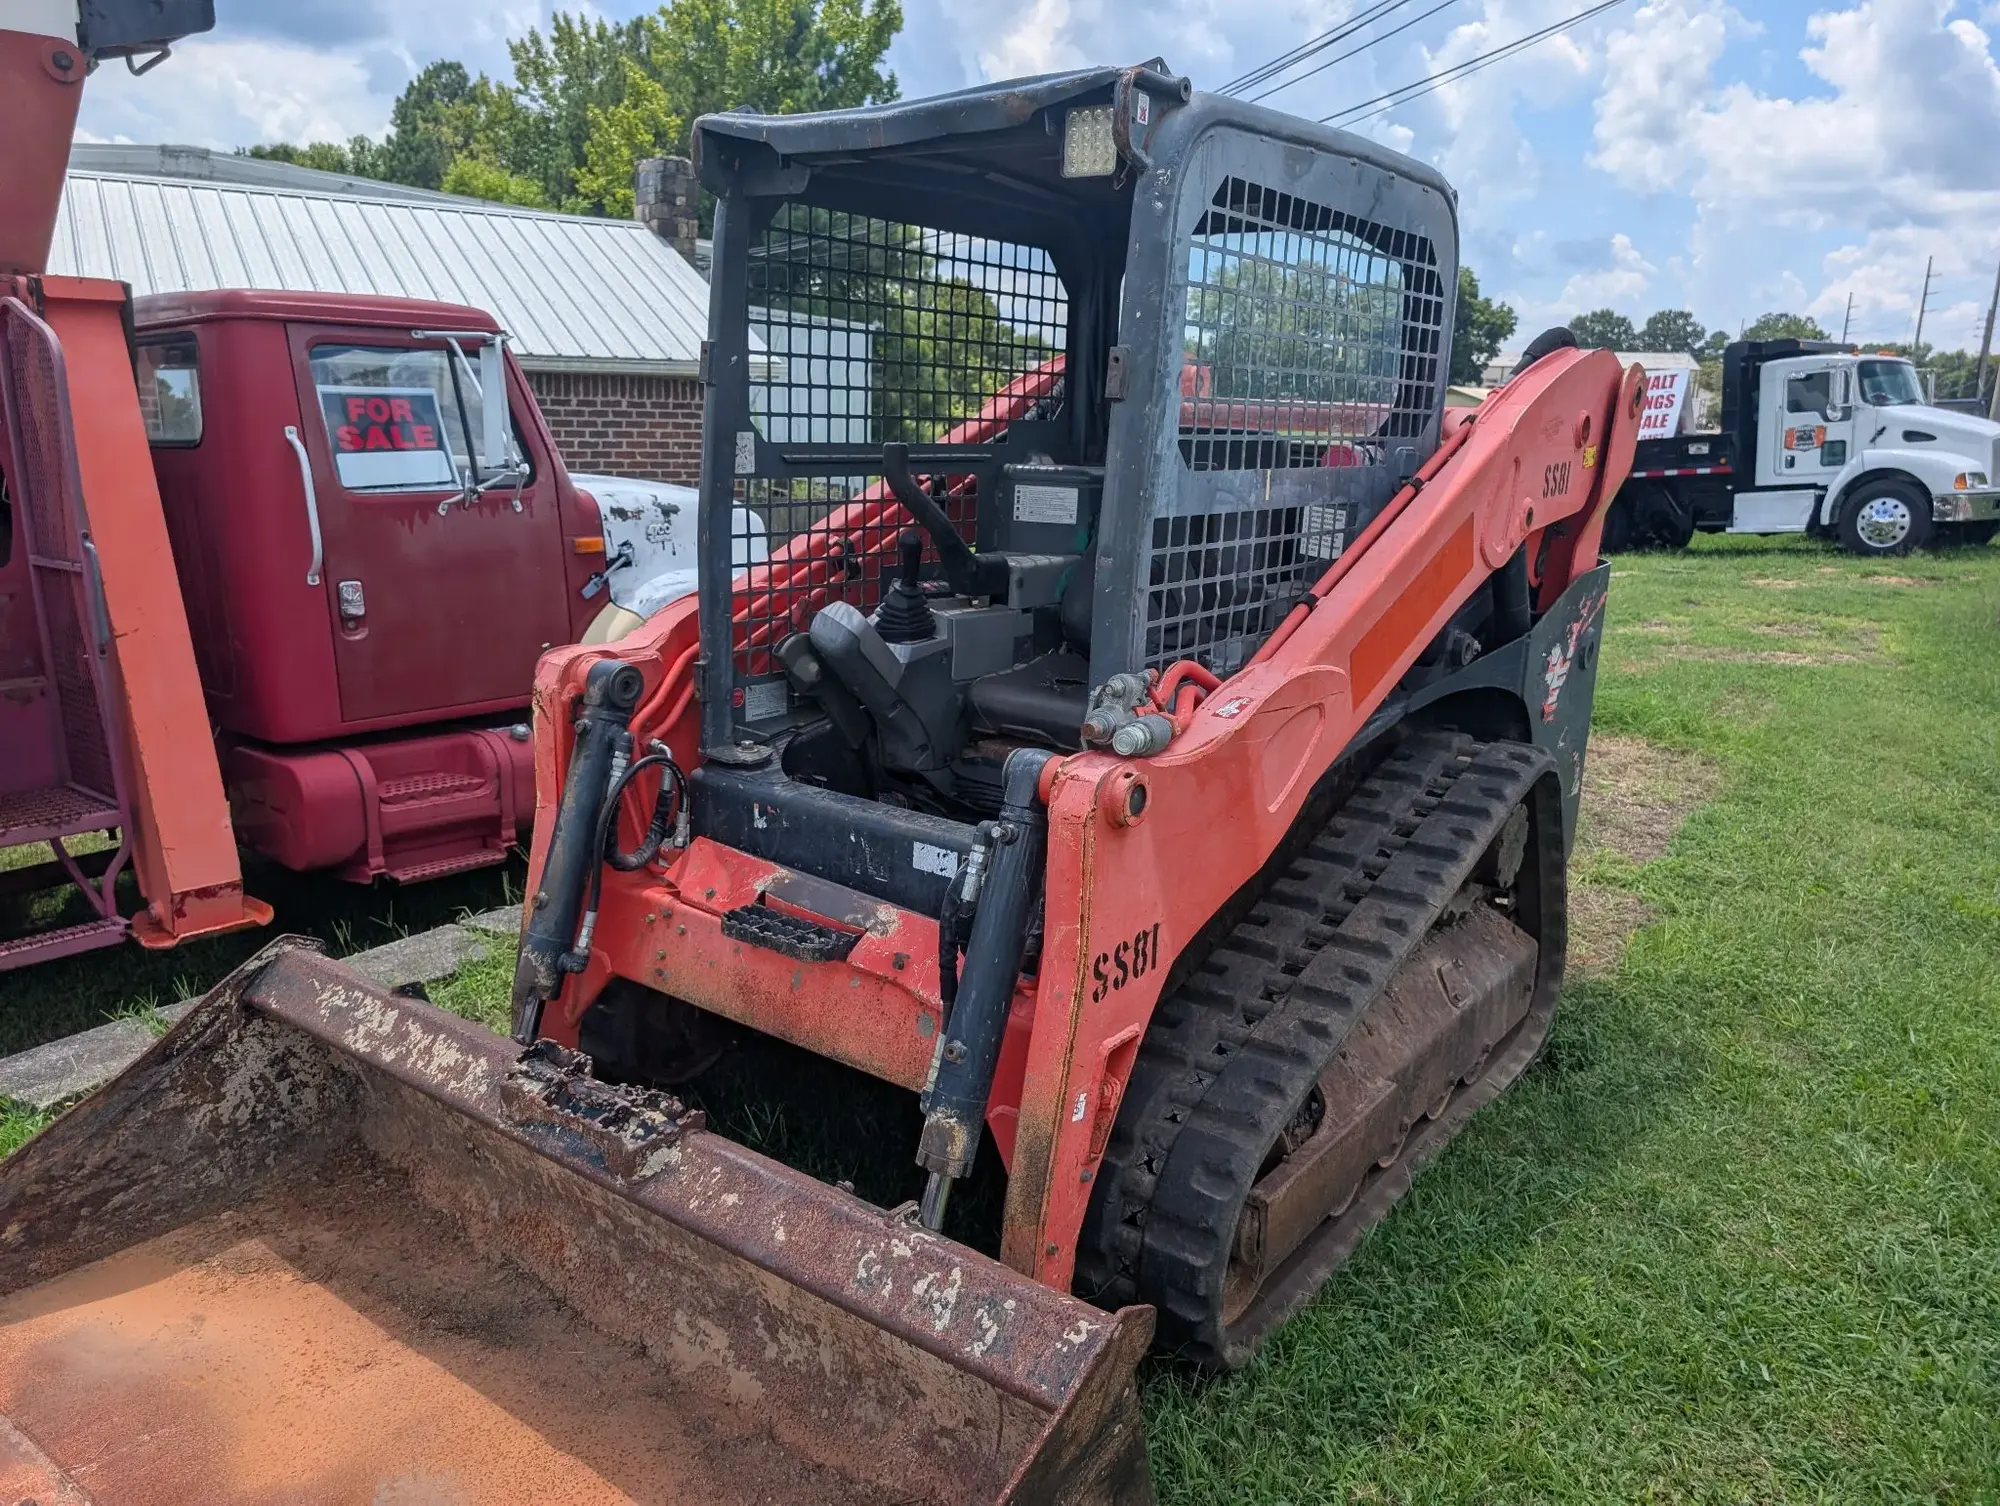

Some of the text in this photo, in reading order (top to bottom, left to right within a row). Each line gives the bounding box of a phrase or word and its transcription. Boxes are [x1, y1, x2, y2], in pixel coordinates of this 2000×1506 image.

[346, 397, 414, 423] FOR
[1638, 414, 1669, 432] ALE
[336, 425, 438, 450] SALE
[1543, 461, 1571, 499] SS81
[1092, 922, 1160, 1004] SS81
